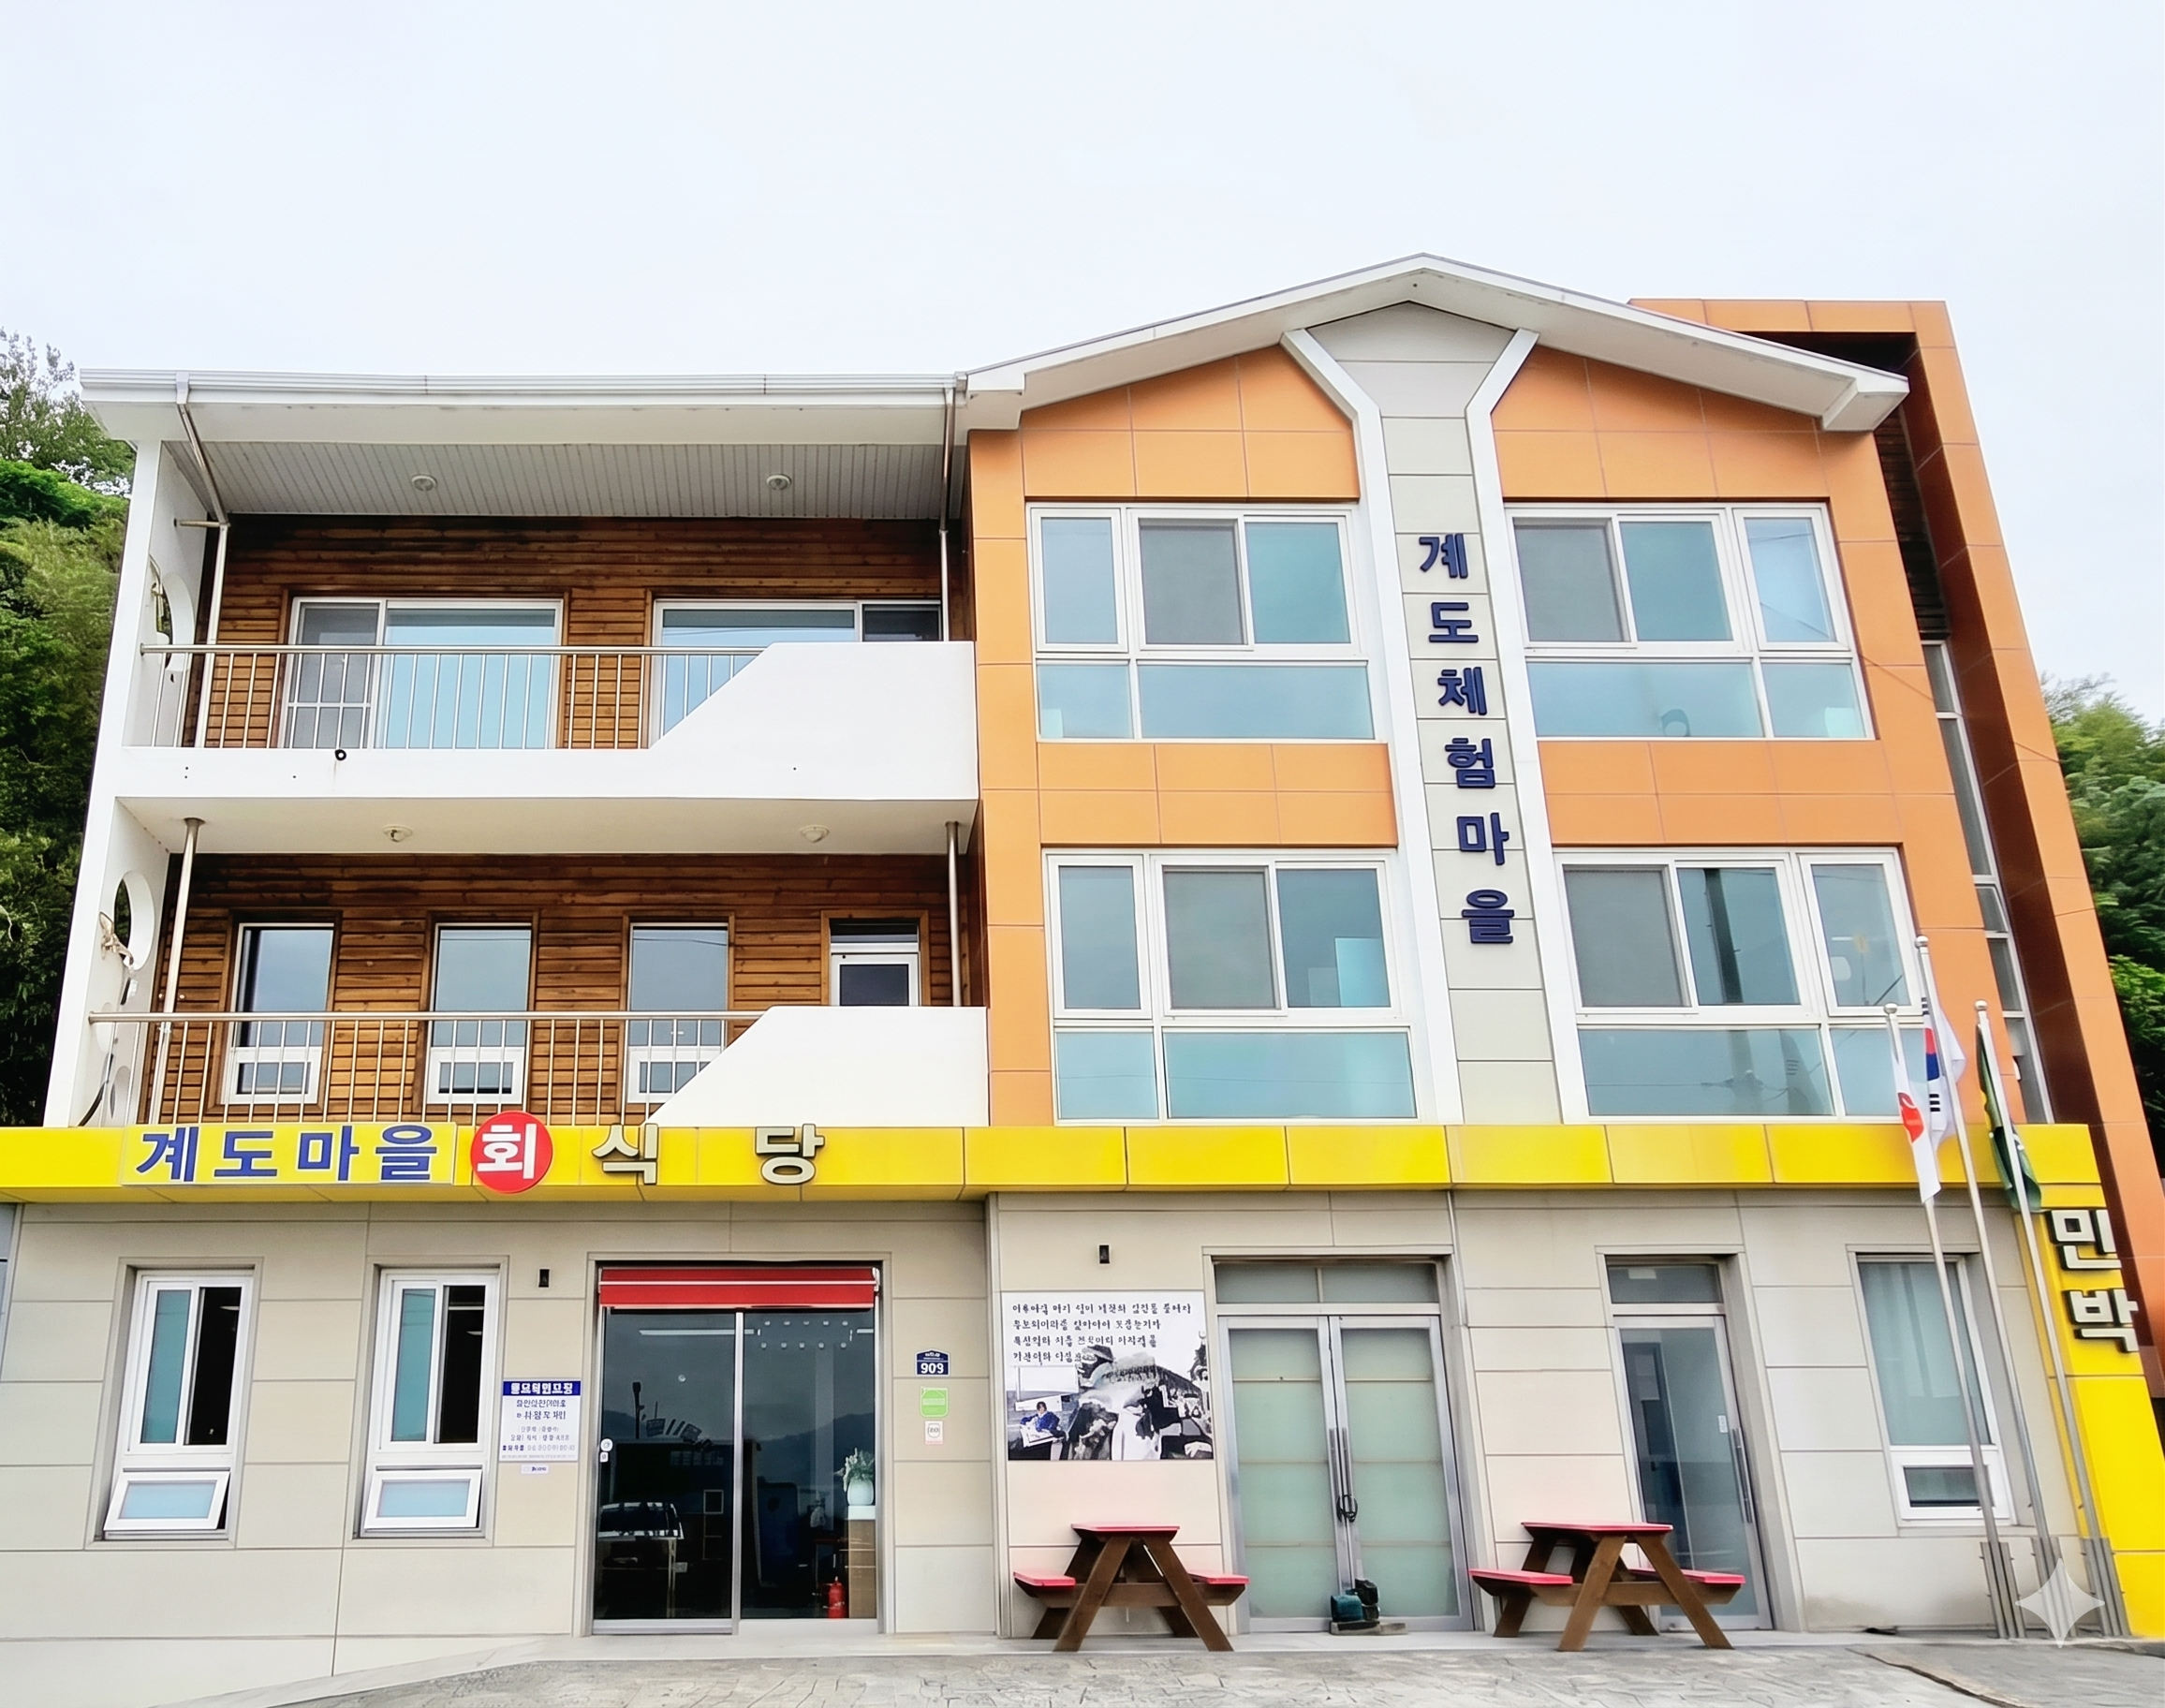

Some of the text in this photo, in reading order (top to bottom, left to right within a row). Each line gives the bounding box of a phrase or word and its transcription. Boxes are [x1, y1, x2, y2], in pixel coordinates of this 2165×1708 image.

[1419, 533, 1515, 945] 계도체험마을
[136, 1125, 437, 1182] 계도마을
[477, 1123, 537, 1180] 회
[2047, 1210, 2139, 1353] 민박
[920, 1362, 944, 1375] 909
